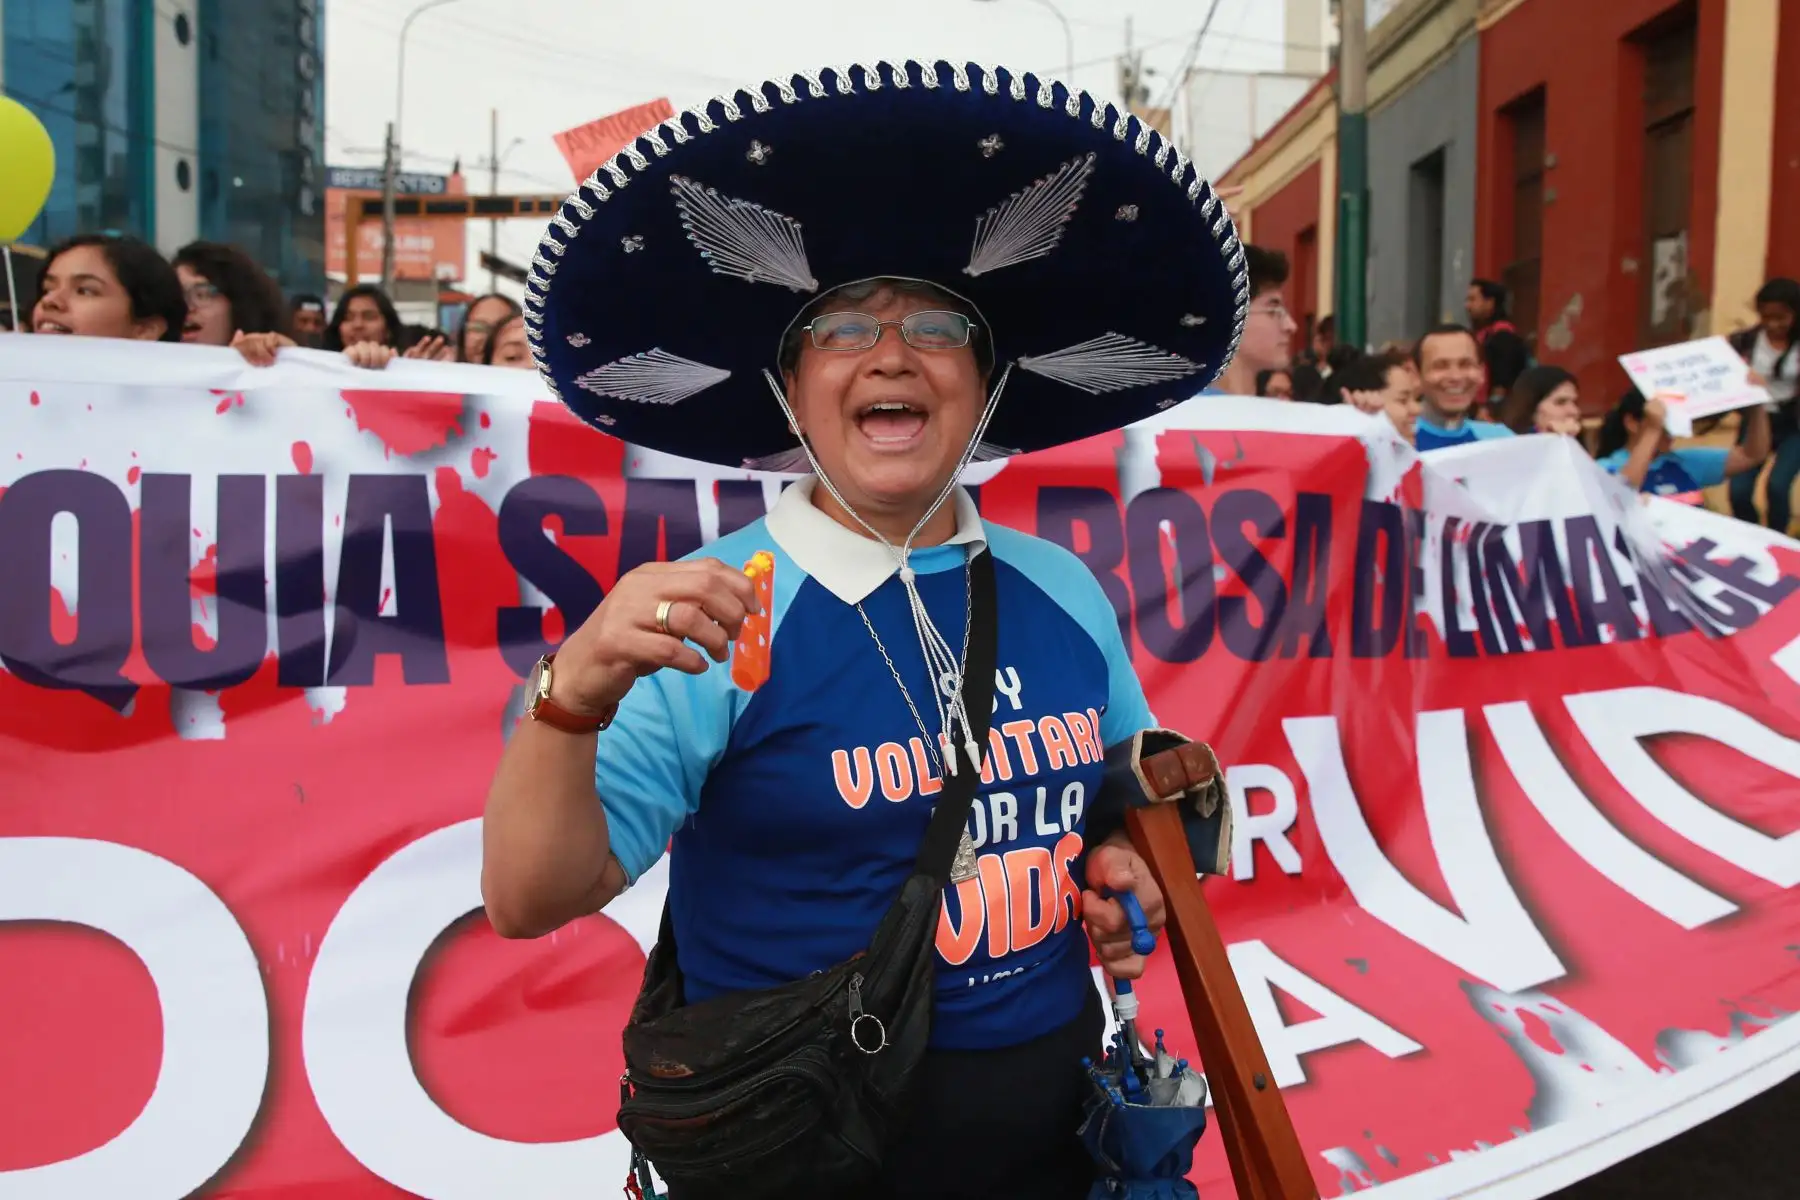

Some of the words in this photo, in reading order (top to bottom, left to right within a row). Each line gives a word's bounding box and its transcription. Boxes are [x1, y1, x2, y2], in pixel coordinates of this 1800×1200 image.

[1036, 486, 1334, 664] ROSA
[938, 666, 1023, 720] SY
[931, 792, 1018, 849] OR
[1035, 781, 1085, 836] LA
[1282, 637, 1800, 994] VID
[935, 831, 1083, 966] VIDA
